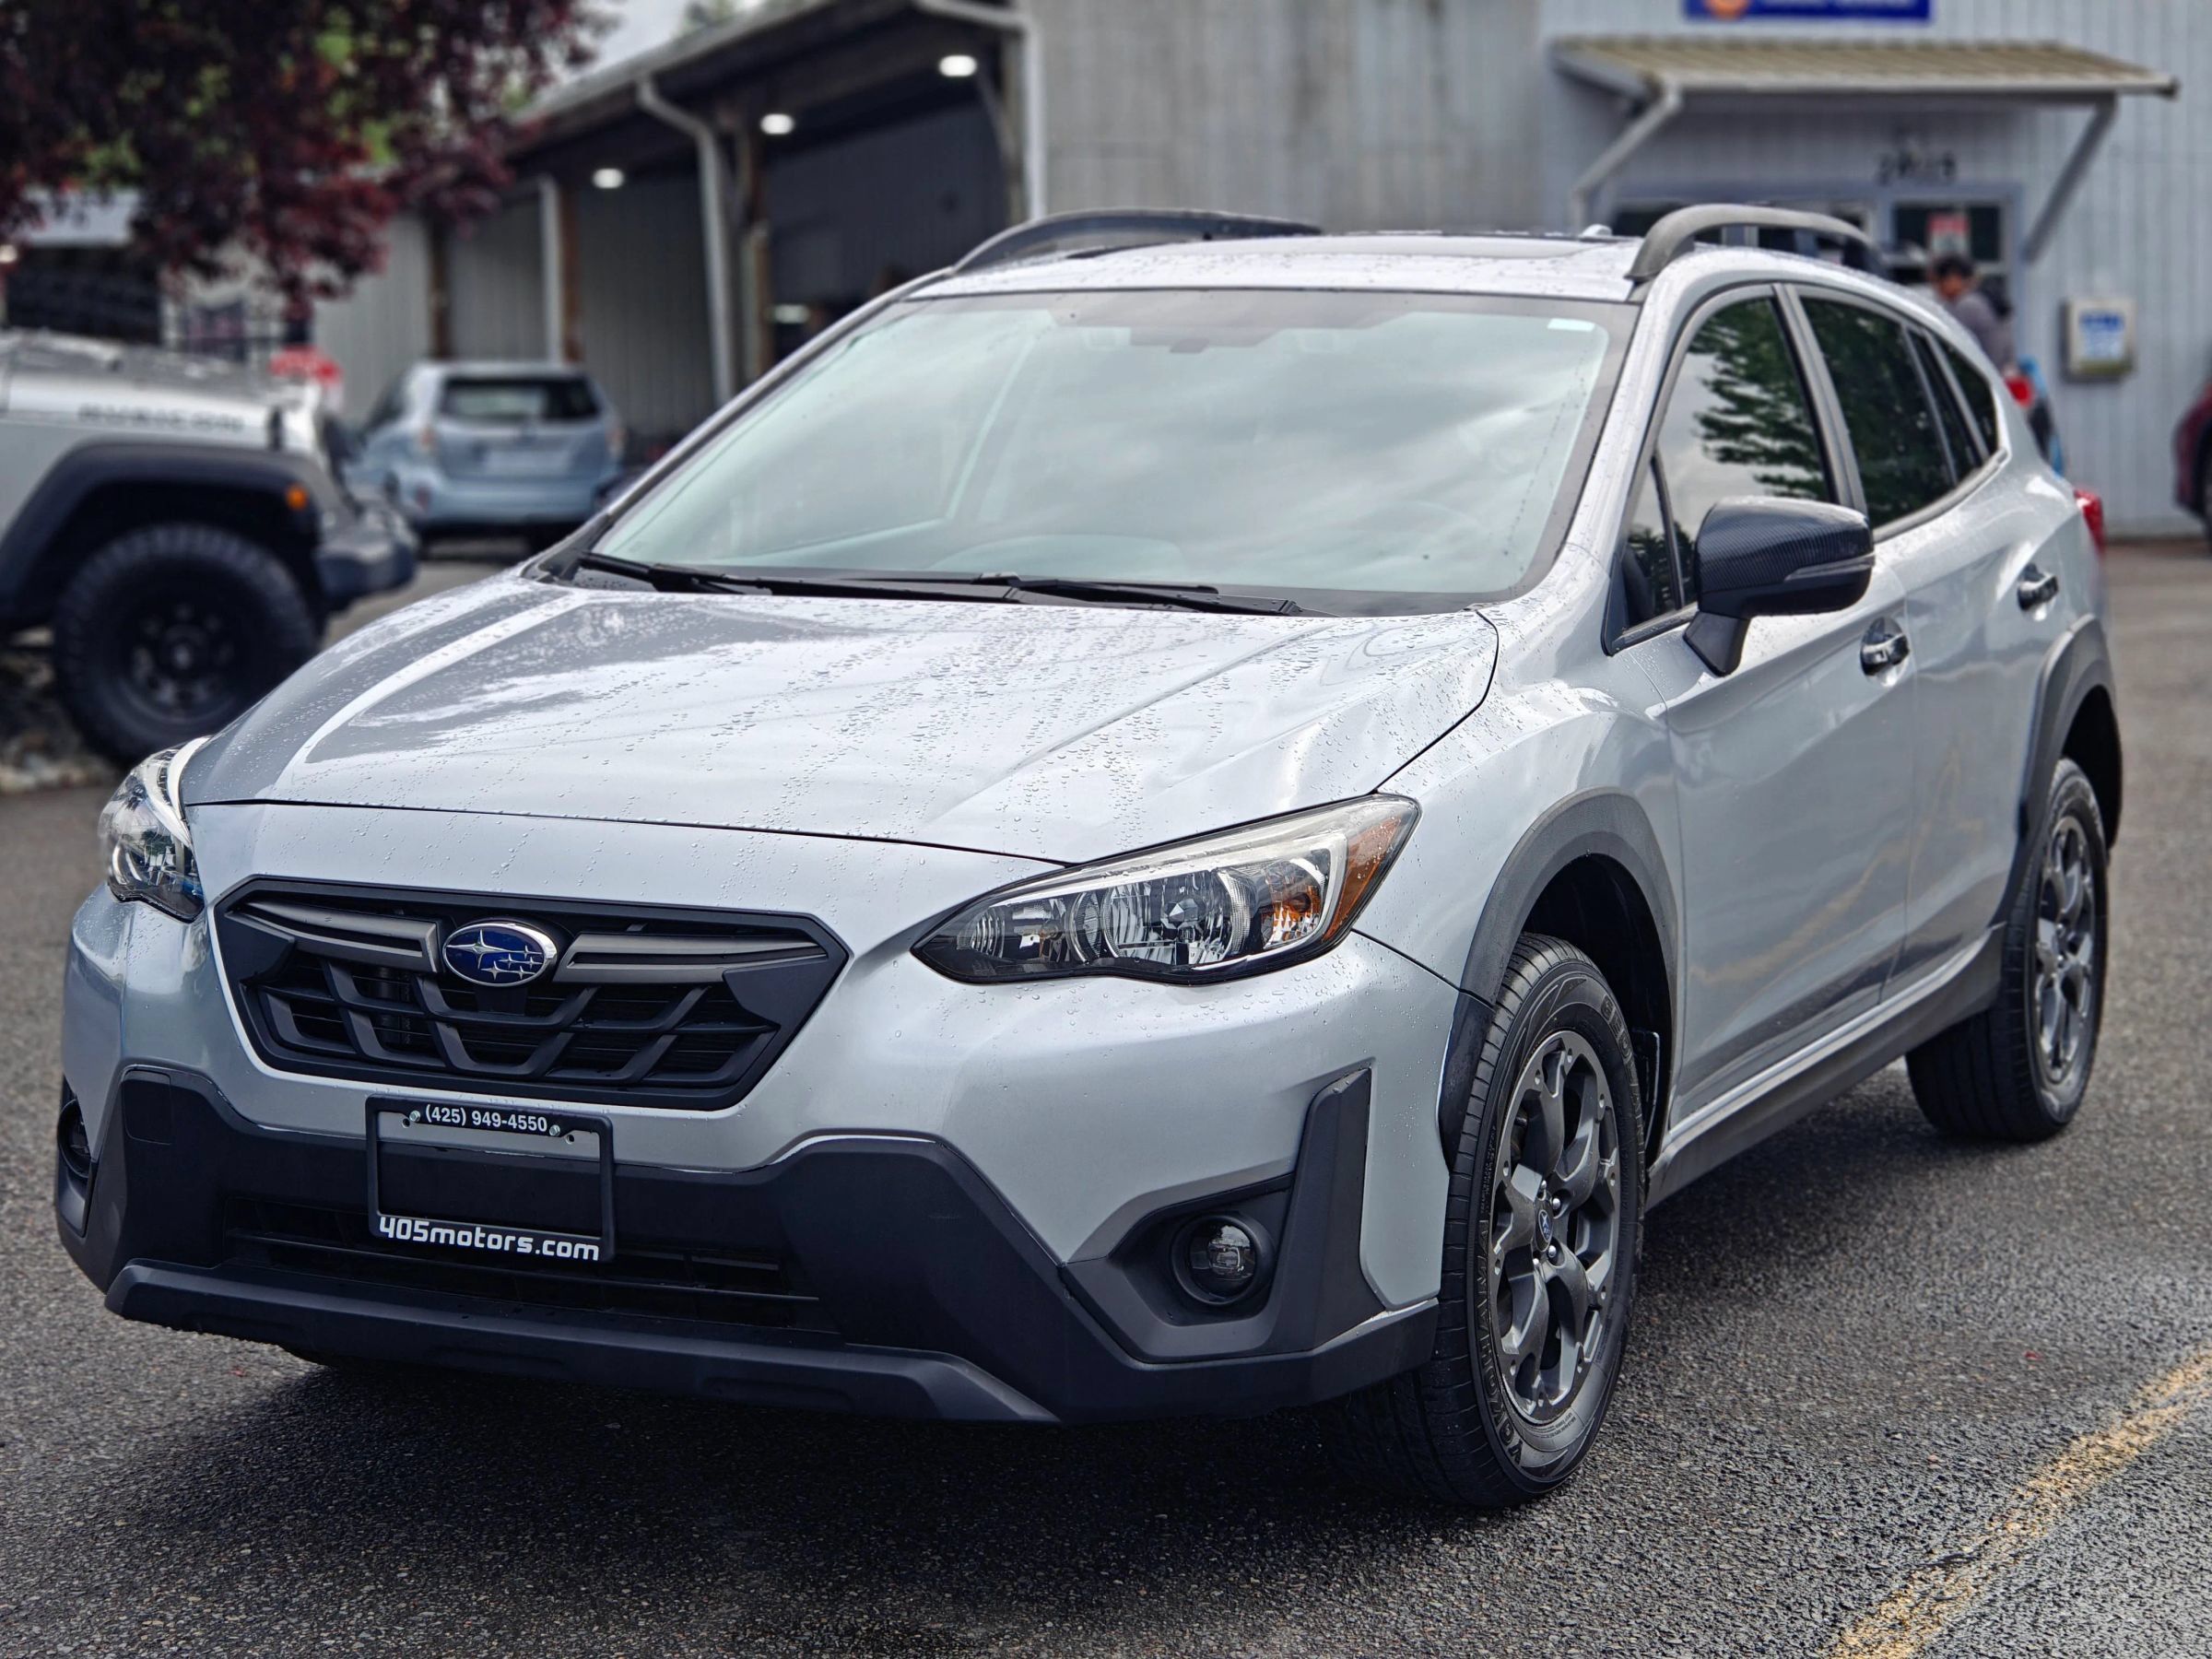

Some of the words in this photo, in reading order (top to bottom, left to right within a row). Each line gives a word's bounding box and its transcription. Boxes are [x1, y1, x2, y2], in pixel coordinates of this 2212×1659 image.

[425, 1104, 466, 1126] (425)
[472, 1110, 547, 1133] 949-4550
[379, 1216, 600, 1262] 405motors.com
